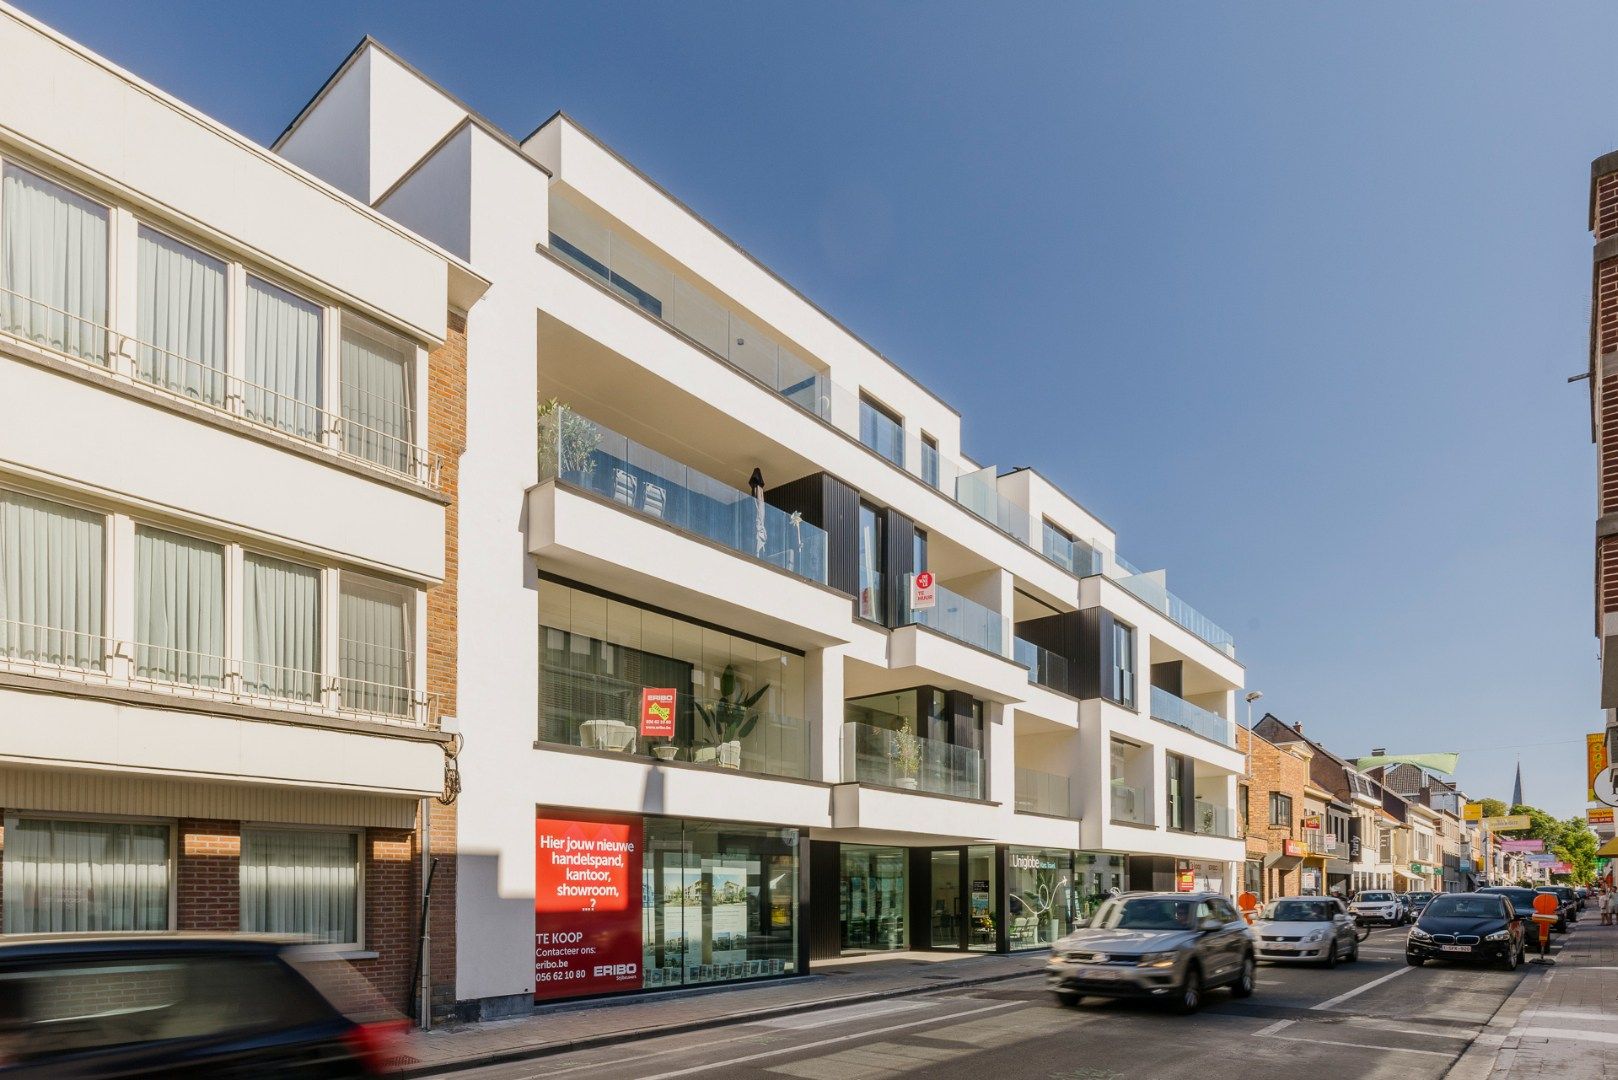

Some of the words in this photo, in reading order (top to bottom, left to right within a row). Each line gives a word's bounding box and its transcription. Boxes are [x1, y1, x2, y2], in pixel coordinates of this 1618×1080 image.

[540, 835, 565, 849] Hier
[566, 836, 594, 852] jouw
[596, 838, 635, 852] nieuwe
[552, 852, 624, 868] handelspand,
[1012, 854, 1040, 870] Uniglobe
[566, 868, 611, 882] kantoor,
[557, 883, 619, 897] showroom,
[536, 933, 549, 944] TE
[552, 932, 583, 944] KOOP
[536, 947, 579, 957] Contacteer
[536, 959, 569, 969] eribo.be
[593, 963, 637, 977] ERIBO
[536, 972, 551, 982] 056
[553, 971, 562, 981] 62
[564, 971, 574, 980] 10
[575, 970, 586, 979] 80
